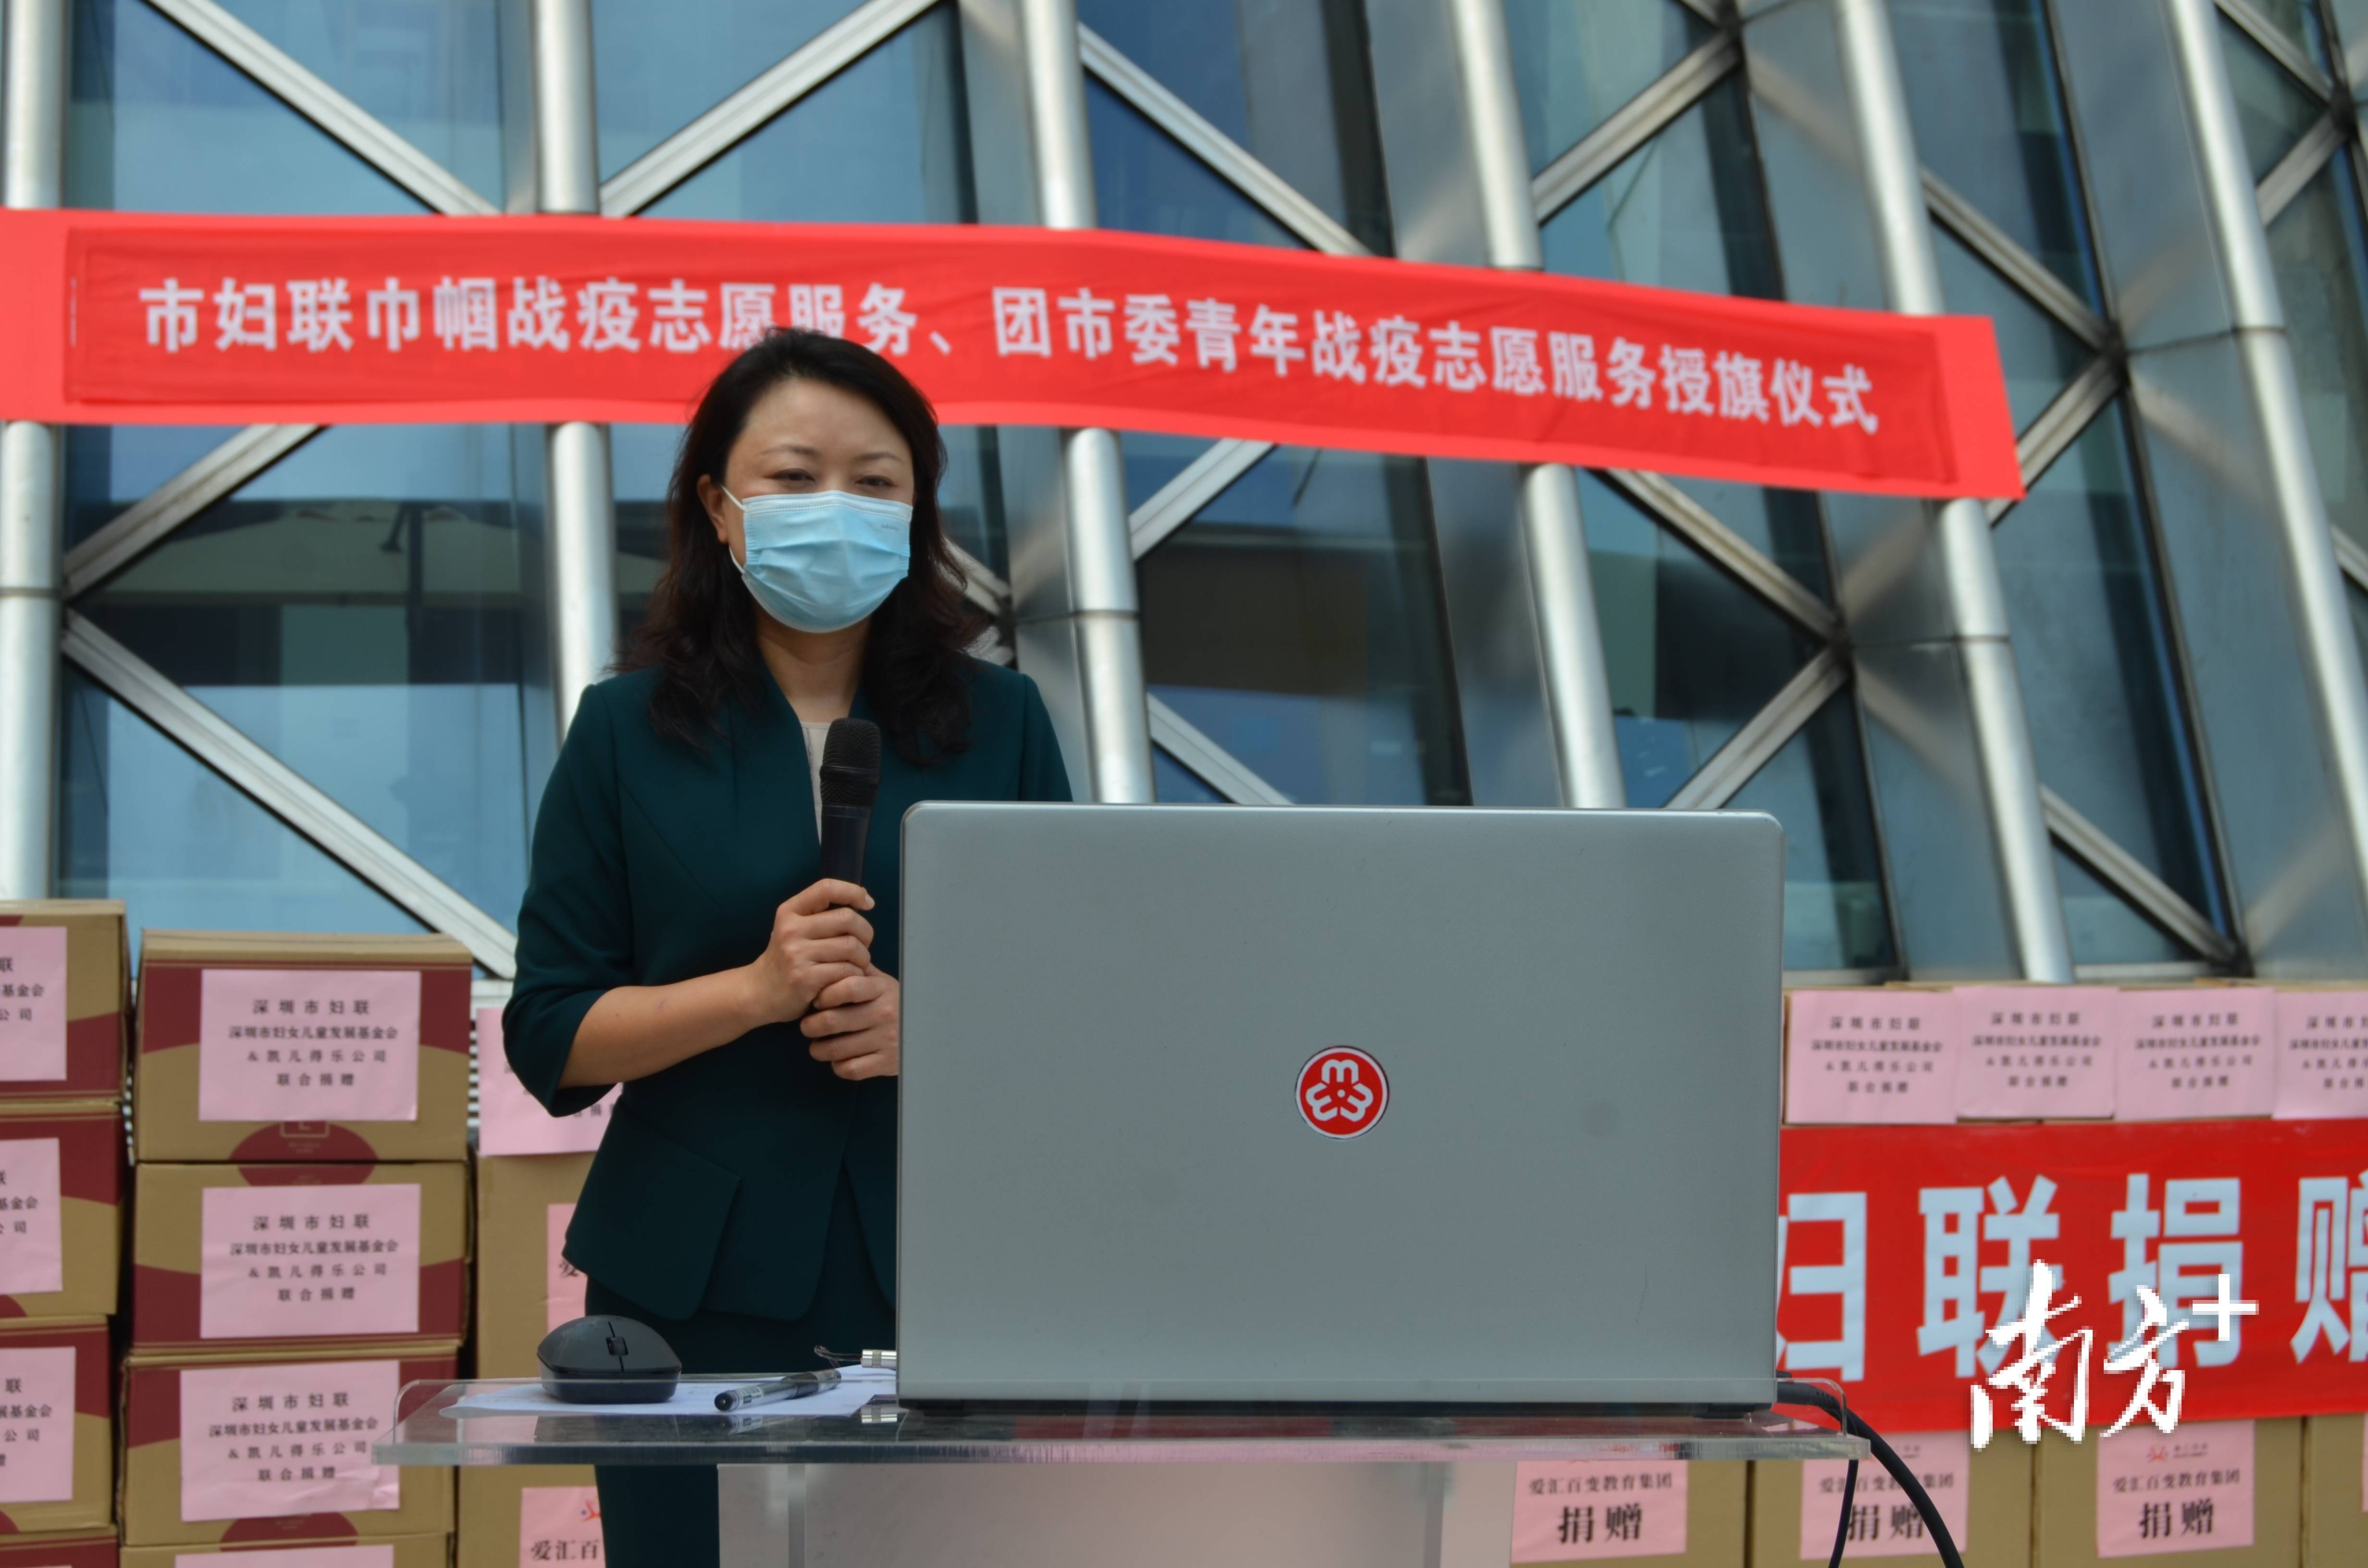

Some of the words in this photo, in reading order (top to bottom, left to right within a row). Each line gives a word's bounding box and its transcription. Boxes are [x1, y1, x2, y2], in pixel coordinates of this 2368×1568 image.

[252, 999, 370, 1016] 深圳市妇联
[229, 1026, 399, 1040] 深圳市妇女儿童发展基金会
[277, 1073, 354, 1086] 联合捐赠
[253, 1213, 369, 1232] 深圳市妇联
[230, 1238, 399, 1256] 深圳市妇女儿童发展基金会
[278, 1286, 355, 1301] 联合捐赠
[232, 1391, 349, 1412] 深圳市妇联
[209, 1416, 379, 1437] 深圳市妇女儿童发展基金会
[258, 1466, 336, 1482] 联合捐赠
[1530, 1472, 1672, 1495] 爱汇百变教育集团
[2113, 1468, 2240, 1492] 爱汇百变教育集团
[1558, 1502, 1641, 1544] 捐赠
[2138, 1497, 2213, 1539] 捐赠
